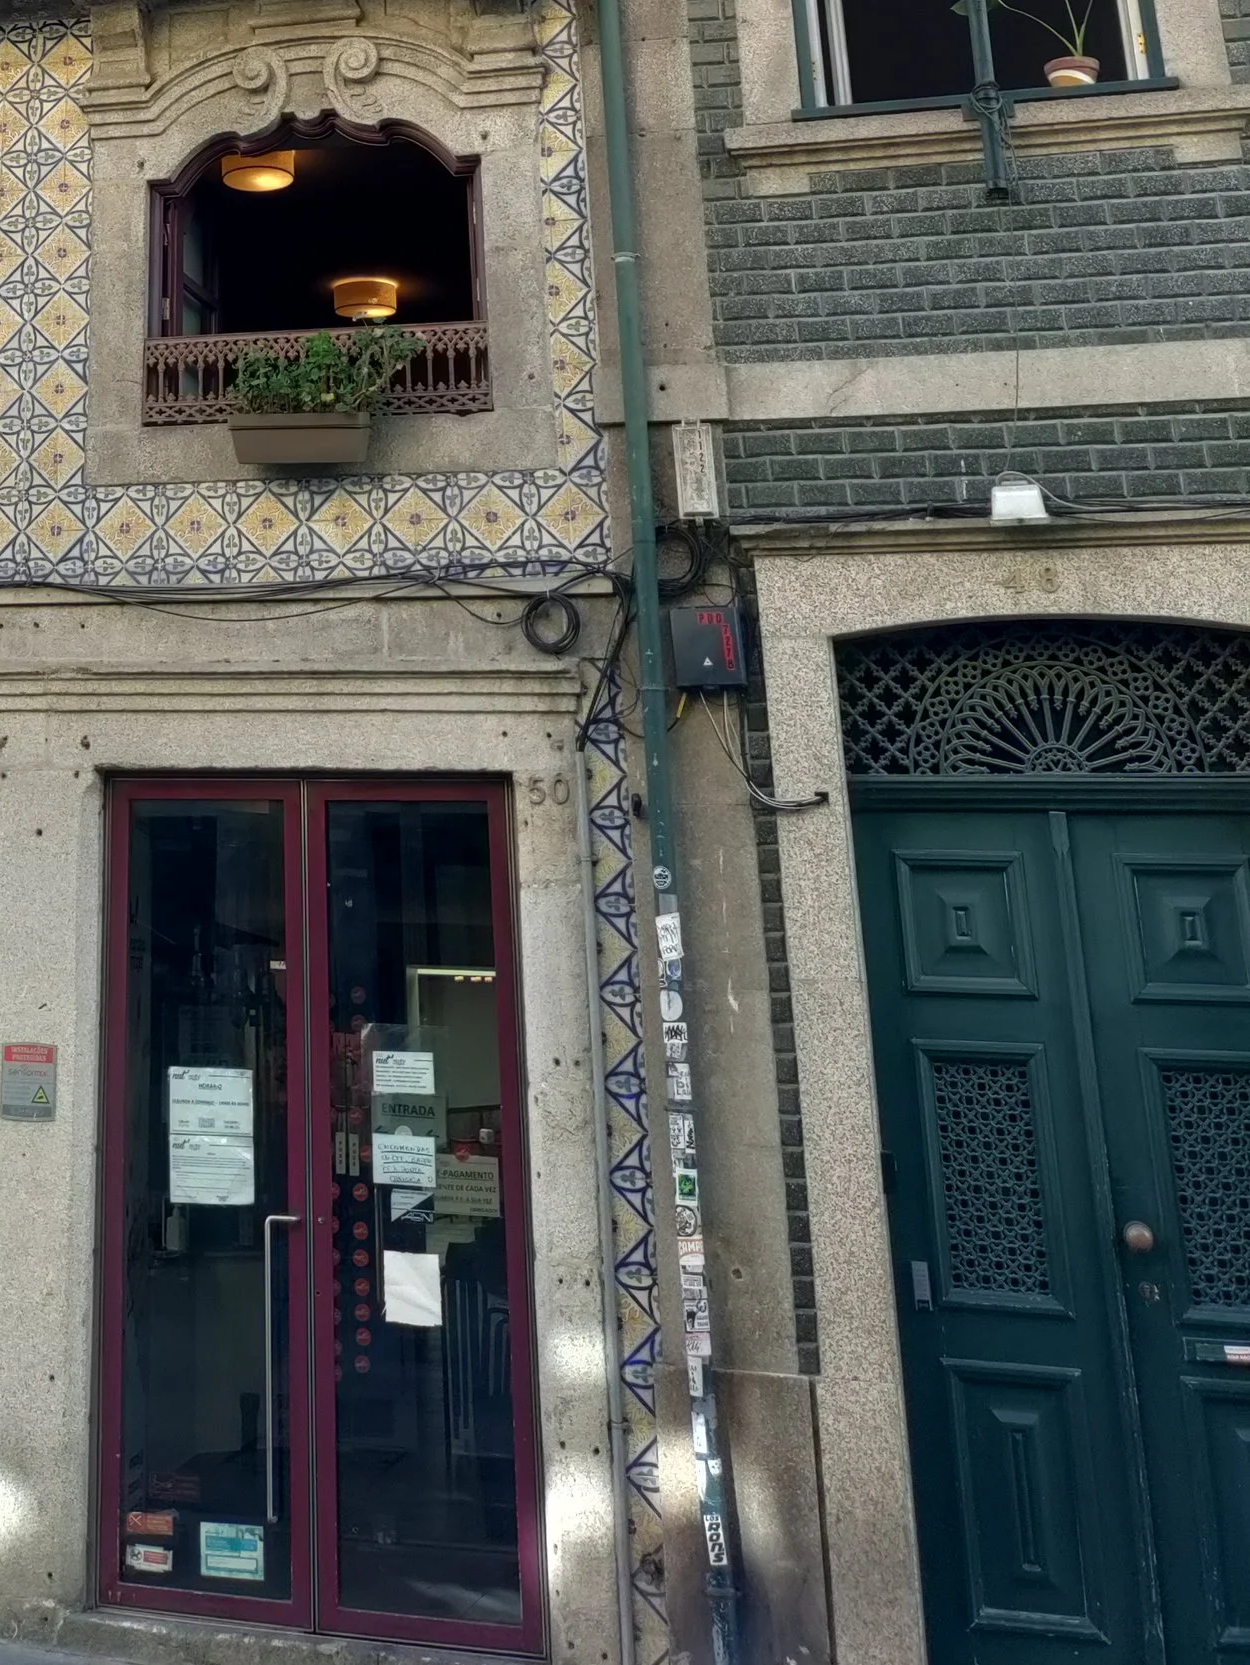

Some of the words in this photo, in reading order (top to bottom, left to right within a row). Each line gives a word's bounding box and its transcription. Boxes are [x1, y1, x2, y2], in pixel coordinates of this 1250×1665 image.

[998, 560, 1060, 593] 48
[529, 772, 570, 805] 50
[381, 1102, 436, 1117] ENTRADA
[465, 1184, 484, 1193] CADA
[484, 1186, 497, 1194] VEZ
